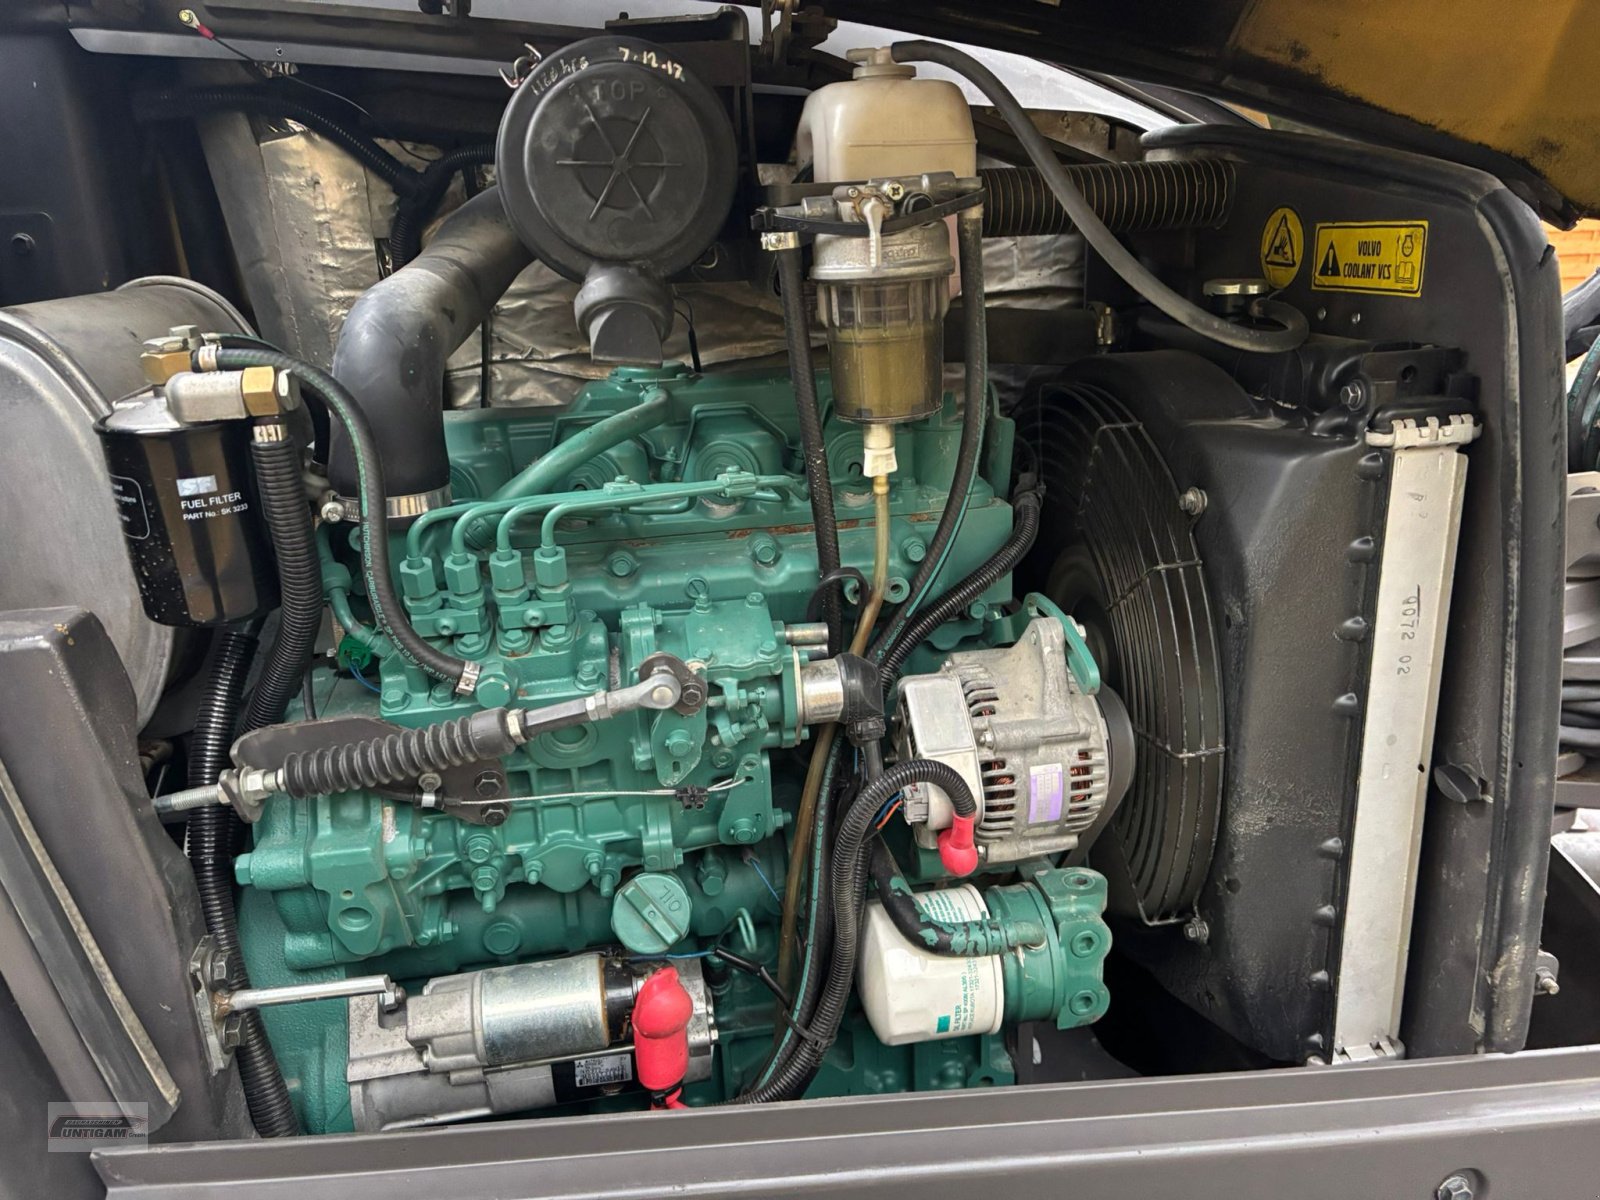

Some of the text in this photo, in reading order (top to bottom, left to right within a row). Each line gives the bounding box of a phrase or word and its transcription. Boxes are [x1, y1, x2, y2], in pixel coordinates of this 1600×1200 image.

[592, 79, 645, 101] TOP
[1357, 240, 1382, 257] VOLVO
[1343, 262, 1391, 280] COOLANT VCS
[181, 491, 242, 510] FUEL FILTER
[183, 511, 204, 520] PART
[221, 506, 232, 515] SK
[362, 521, 372, 568] HUTCHINSON
[660, 885, 681, 912] OIL
[954, 1004, 962, 1023] FILTER
